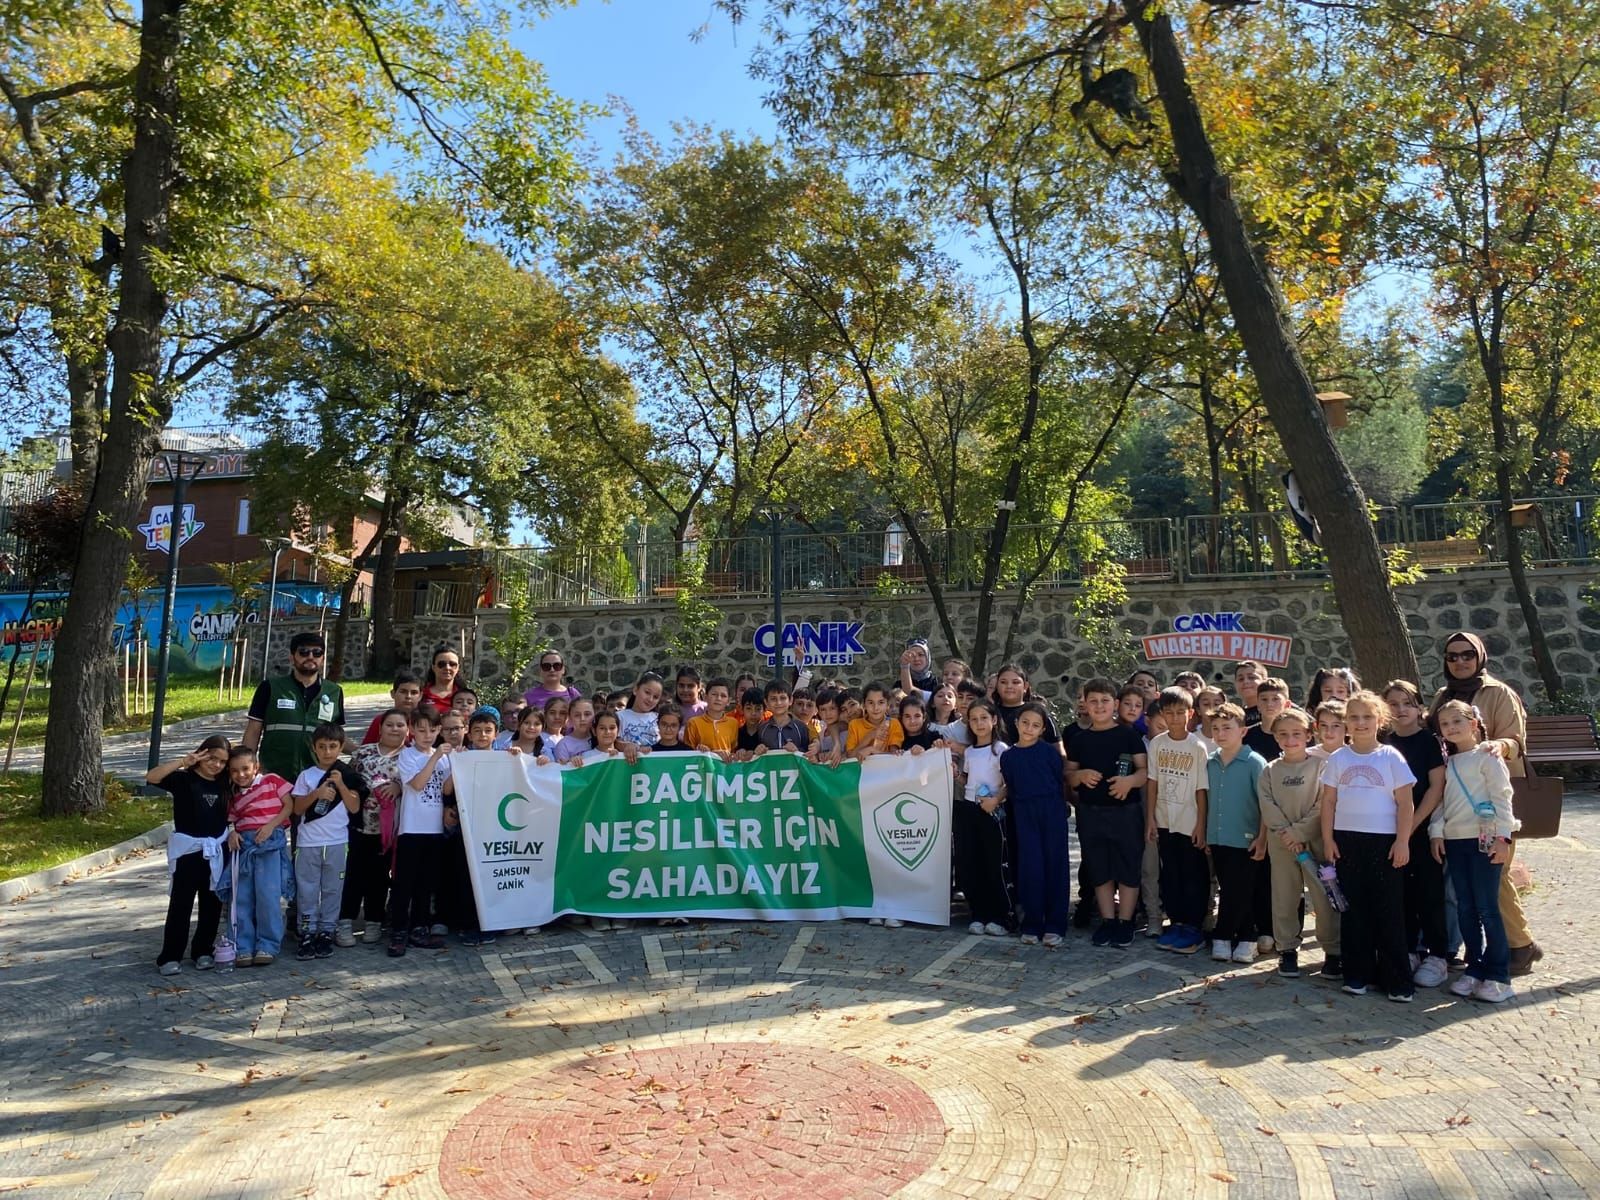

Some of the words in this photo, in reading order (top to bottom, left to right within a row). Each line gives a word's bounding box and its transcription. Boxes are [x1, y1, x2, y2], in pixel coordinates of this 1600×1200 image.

[190, 613, 241, 635] CANİK
[1174, 612, 1244, 632] CANİK
[753, 622, 866, 655] CANİK
[1148, 635, 1225, 657] MACERA
[1230, 636, 1288, 663] PARKI
[768, 655, 852, 666] BLDİYESİ
[630, 764, 801, 804] BAĞIMSIZ
[584, 810, 763, 853] NESİLLER
[773, 806, 840, 852] İÇİN
[886, 828, 928, 840] YEŞİLAY
[482, 840, 544, 856] YEŞİLAY
[493, 866, 530, 878] SAMSUN
[607, 862, 821, 899] SAHADAYIZ
[497, 878, 525, 890] CANİK
